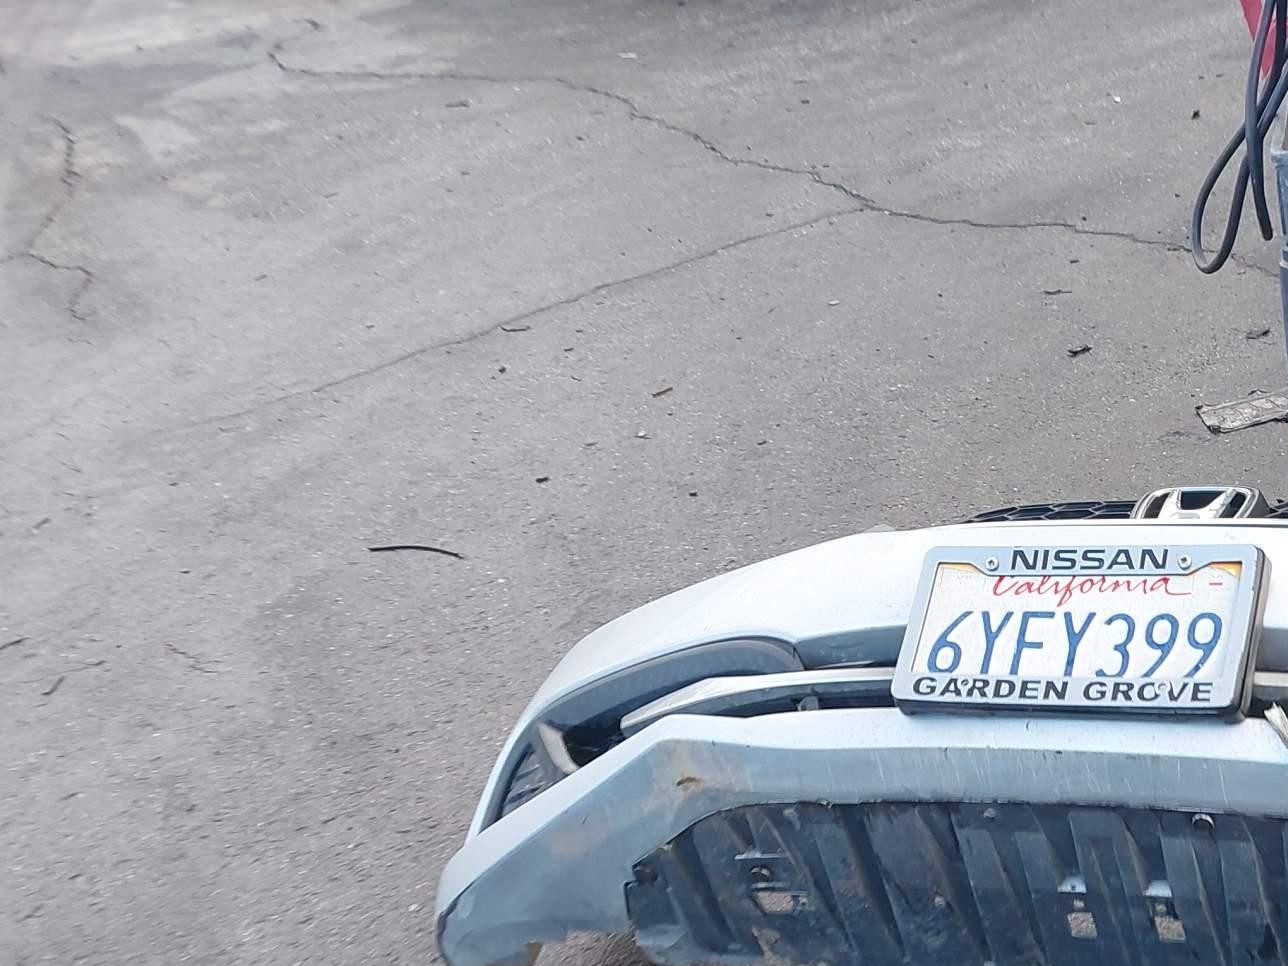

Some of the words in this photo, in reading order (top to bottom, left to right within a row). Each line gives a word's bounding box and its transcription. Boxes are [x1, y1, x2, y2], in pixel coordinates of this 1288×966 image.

[1010, 548, 1169, 571] NISSAN
[992, 575, 1192, 608] California
[926, 609, 1223, 678] 6YFY399
[912, 676, 1069, 701] GARDEN
[1082, 680, 1214, 703] GROVE
